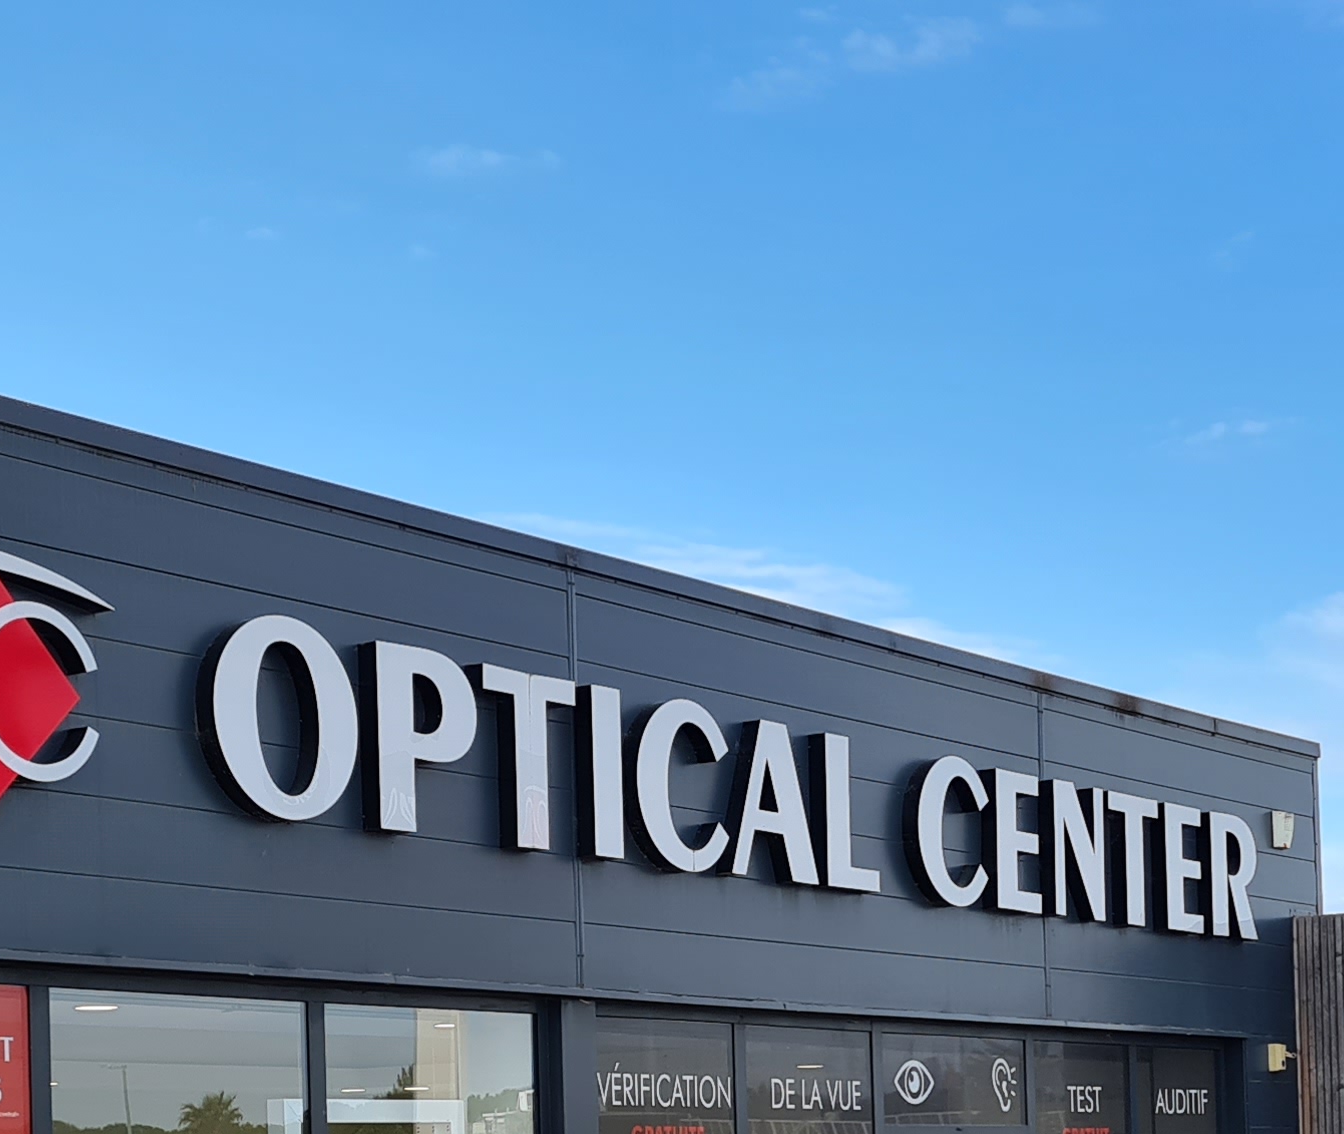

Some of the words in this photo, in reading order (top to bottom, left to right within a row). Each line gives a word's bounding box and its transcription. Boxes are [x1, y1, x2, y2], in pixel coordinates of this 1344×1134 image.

[208, 614, 881, 894] OPTICAL
[914, 755, 1259, 941] CENTER
[596, 1062, 732, 1109] VÉRIFICATION
[771, 1078, 796, 1110] DE
[801, 1079, 824, 1111] LA
[826, 1079, 862, 1111] VUE
[1066, 1085, 1103, 1114] TEST
[1155, 1088, 1208, 1115] AUDITIF
